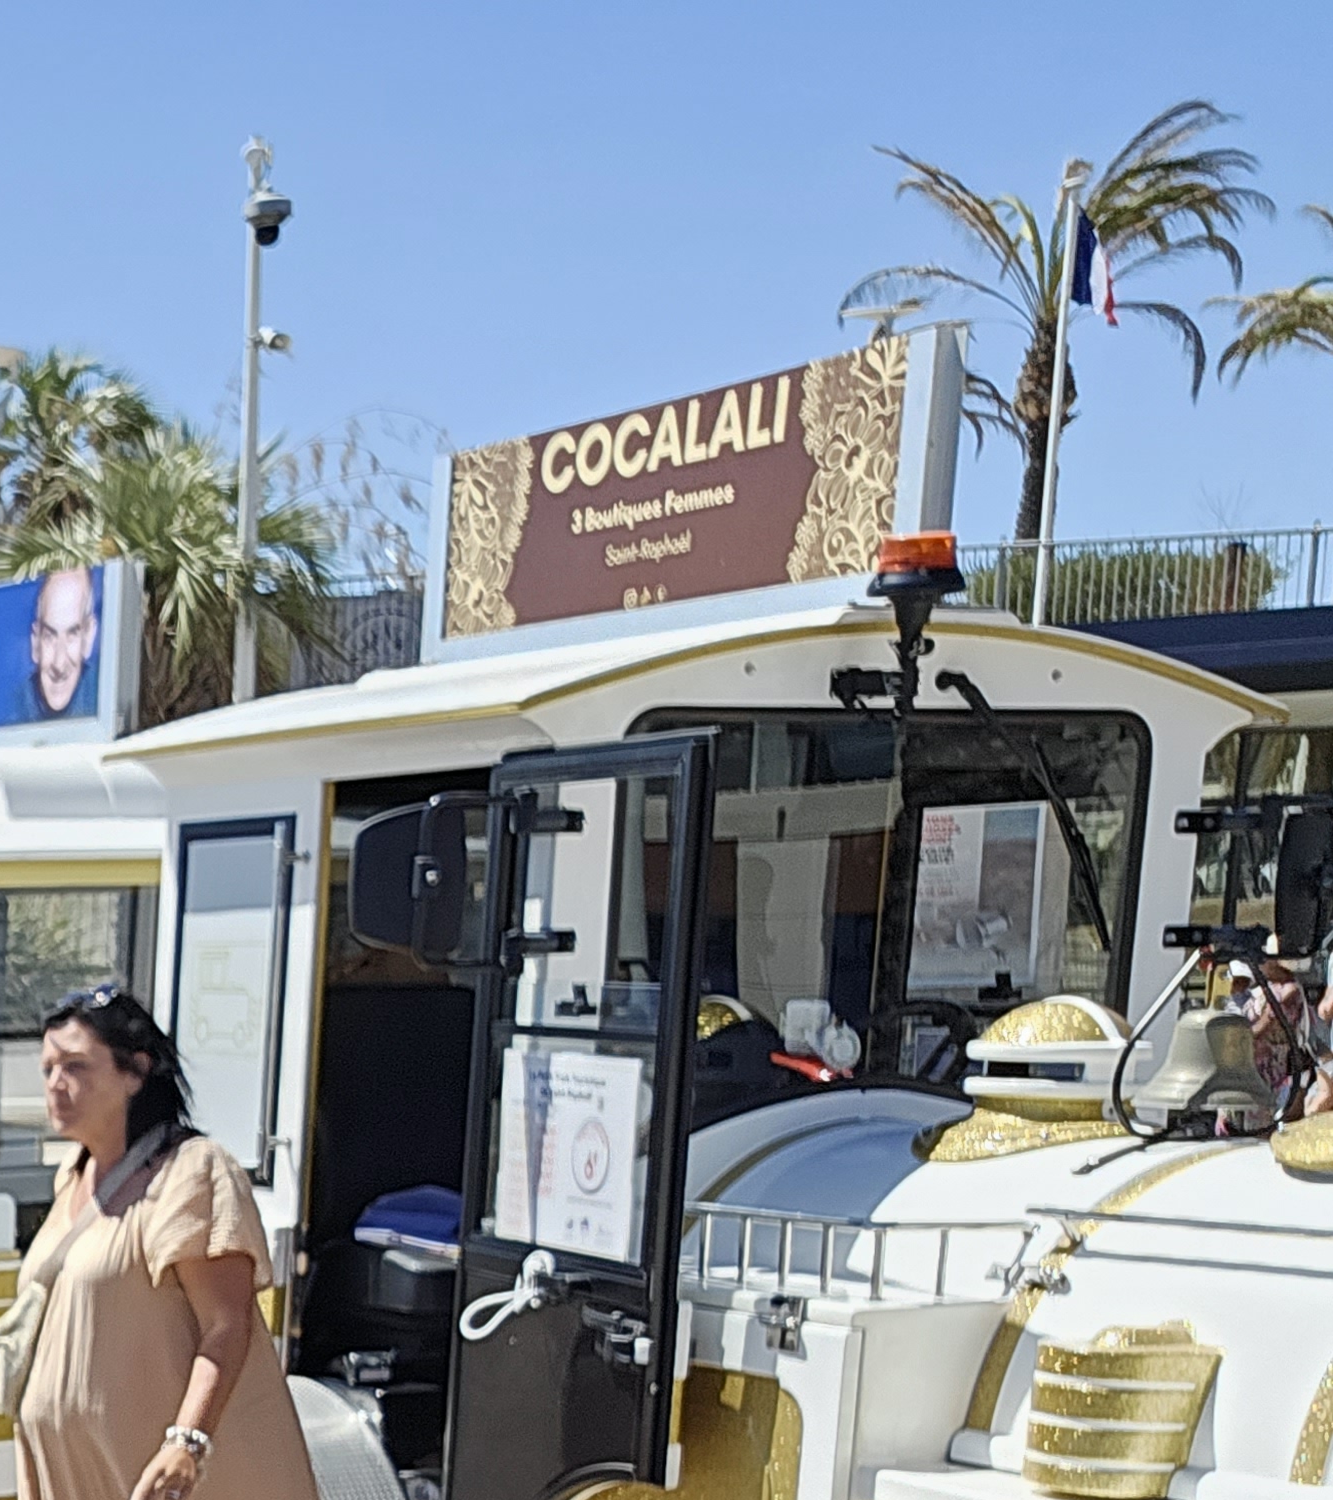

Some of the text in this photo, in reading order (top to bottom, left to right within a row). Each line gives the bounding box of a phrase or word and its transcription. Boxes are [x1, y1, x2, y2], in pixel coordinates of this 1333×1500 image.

[541, 374, 791, 494] COCALALI
[571, 483, 735, 535] 3 Boutiques Femmes
